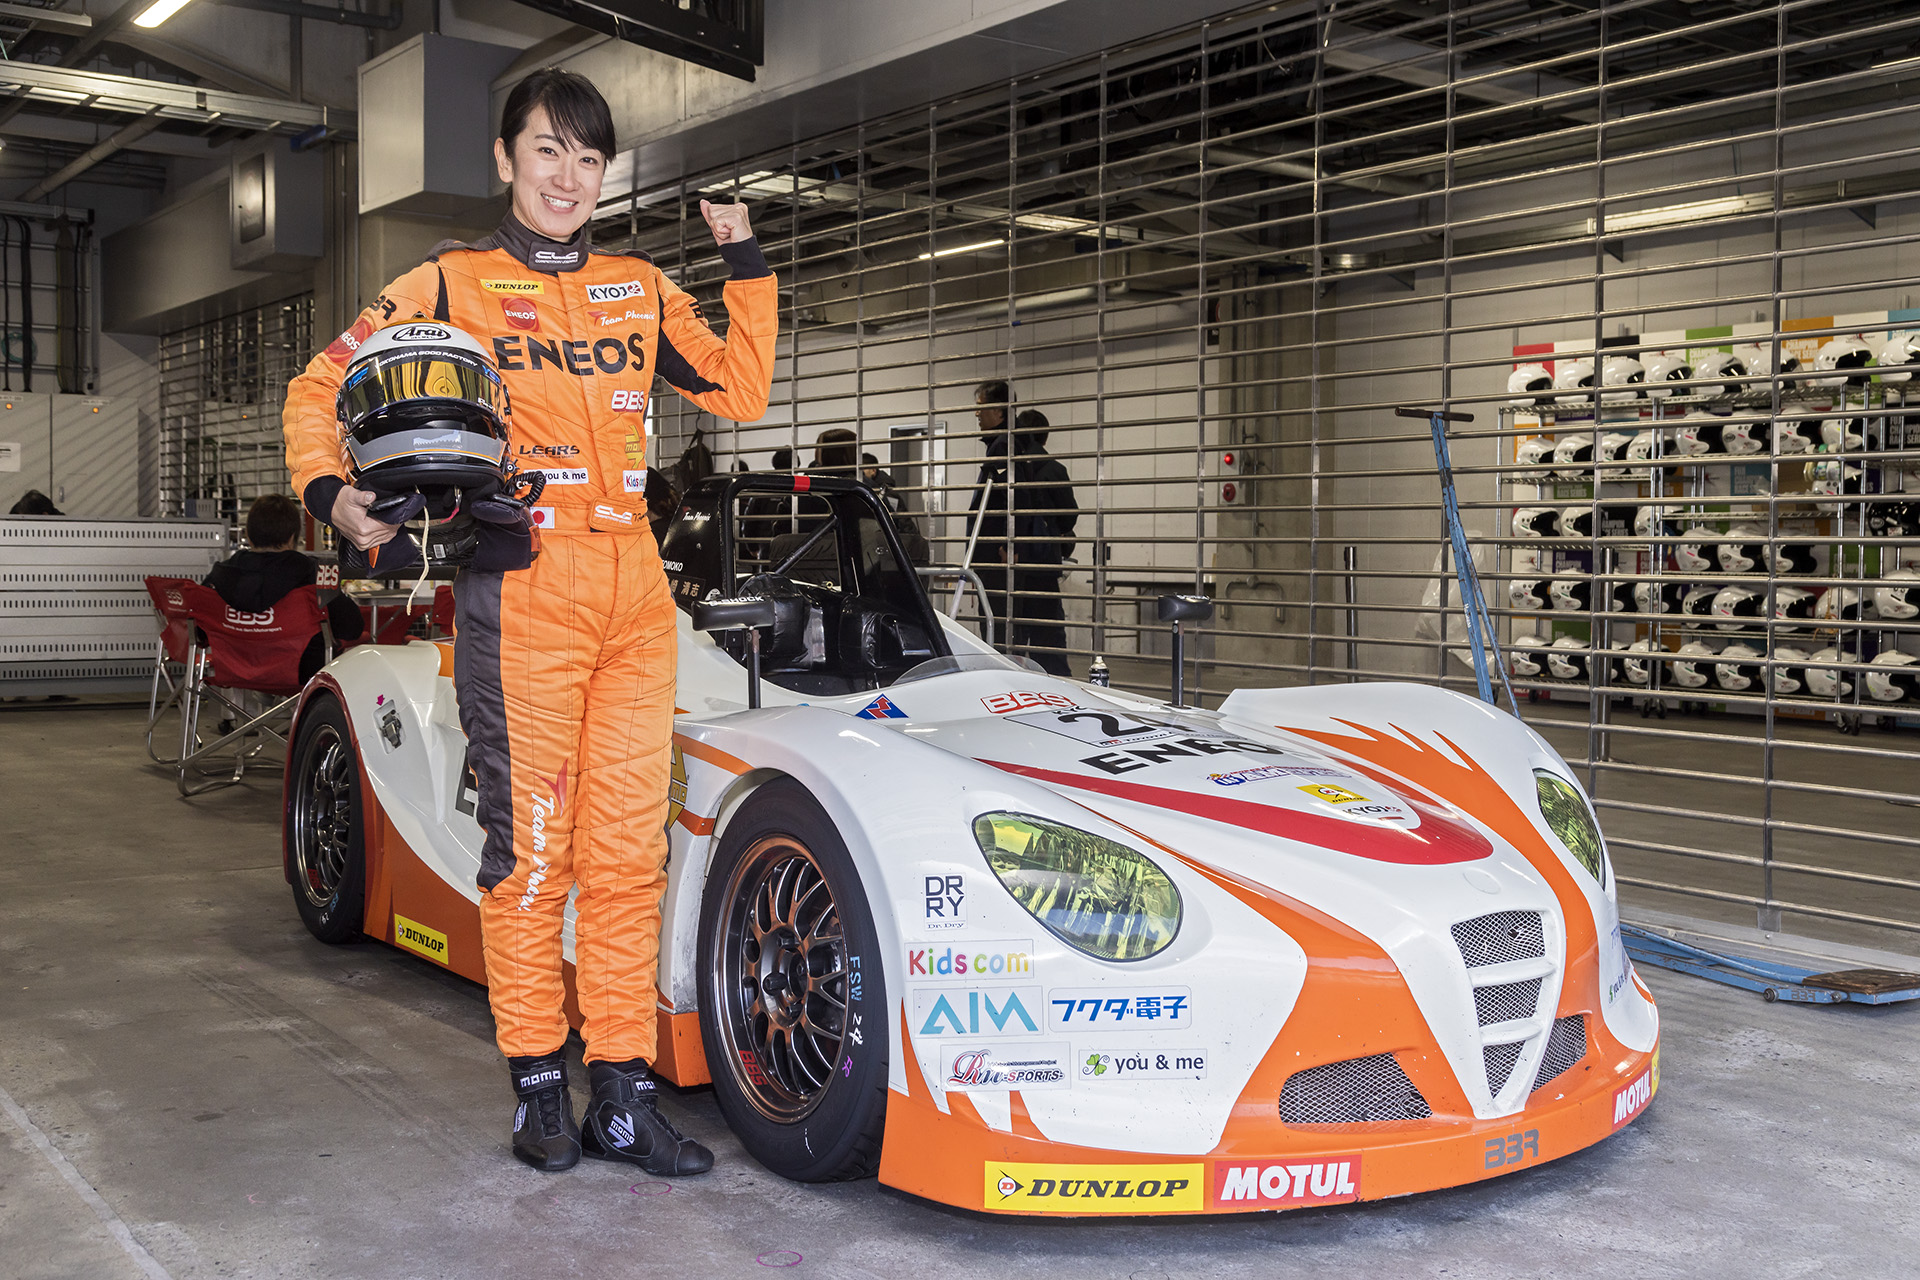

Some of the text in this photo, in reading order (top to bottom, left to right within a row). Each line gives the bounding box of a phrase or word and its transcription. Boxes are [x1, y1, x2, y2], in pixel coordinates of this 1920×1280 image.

[505, 309, 536, 320] ENEOS
[600, 310, 655, 327] Team Phoenix
[339, 331, 361, 351] NEOS
[399, 327, 445, 339] Arai
[442, 351, 478, 367] FACTORY
[493, 332, 645, 376] ENEOS
[611, 389, 645, 413] BBS
[519, 445, 580, 455] LEARS
[981, 690, 1076, 713] BBS
[531, 792, 555, 853] Team
[925, 875, 964, 896] DR
[926, 896, 964, 918] RY
[405, 927, 444, 953] DUNLOP
[909, 947, 1028, 975] Kids com
[850, 956, 862, 1001] FSW
[1052, 995, 1188, 1022] フクダ電子
[849, 1012, 864, 1047] 24
[739, 1050, 768, 1086] BBS
[1115, 1055, 1204, 1074] you & me
[520, 1070, 562, 1088] momo
[1614, 1069, 1650, 1125] MOTUL
[610, 1119, 635, 1145] momo
[1027, 1178, 1190, 1198] DUNLOP
[1220, 1162, 1355, 1201] MOTUL
